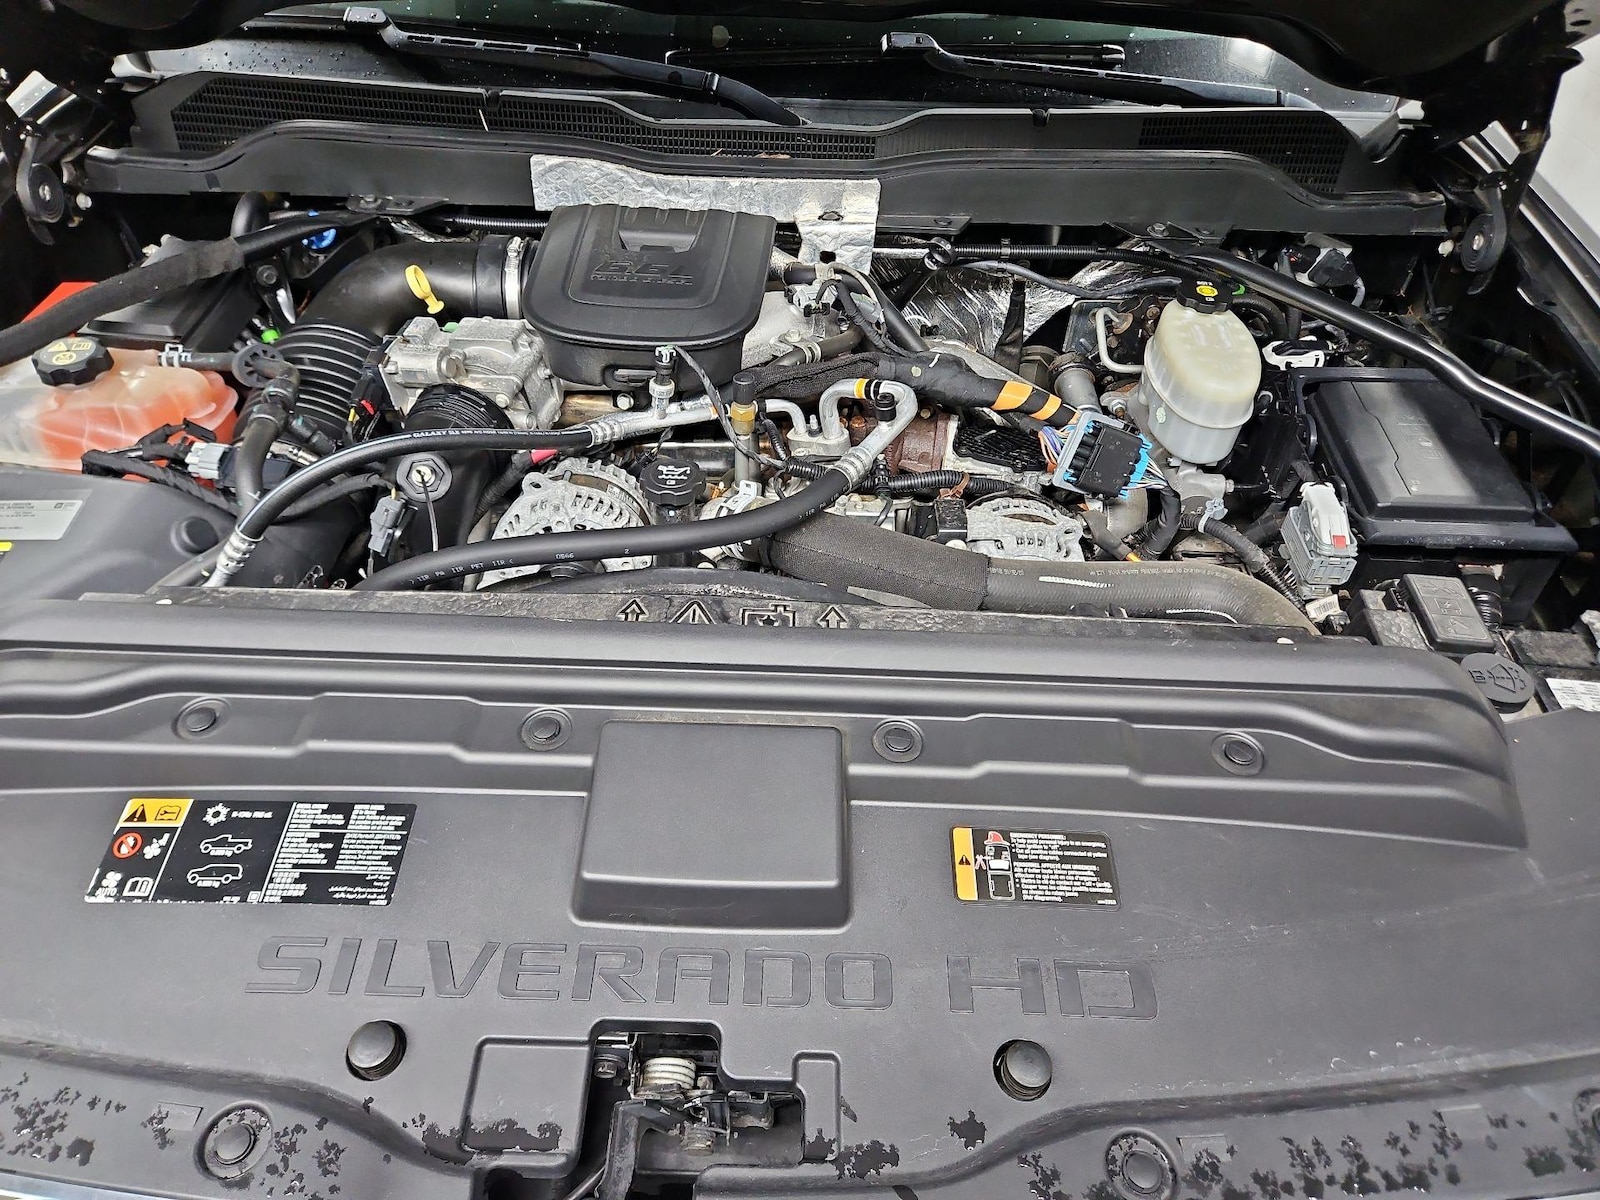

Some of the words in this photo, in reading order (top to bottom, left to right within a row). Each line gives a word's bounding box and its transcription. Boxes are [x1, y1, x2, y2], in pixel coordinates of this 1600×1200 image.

[95, 887, 118, 896] AUTO
[245, 936, 893, 1011] SILVERADO
[946, 955, 1158, 1020] HD
